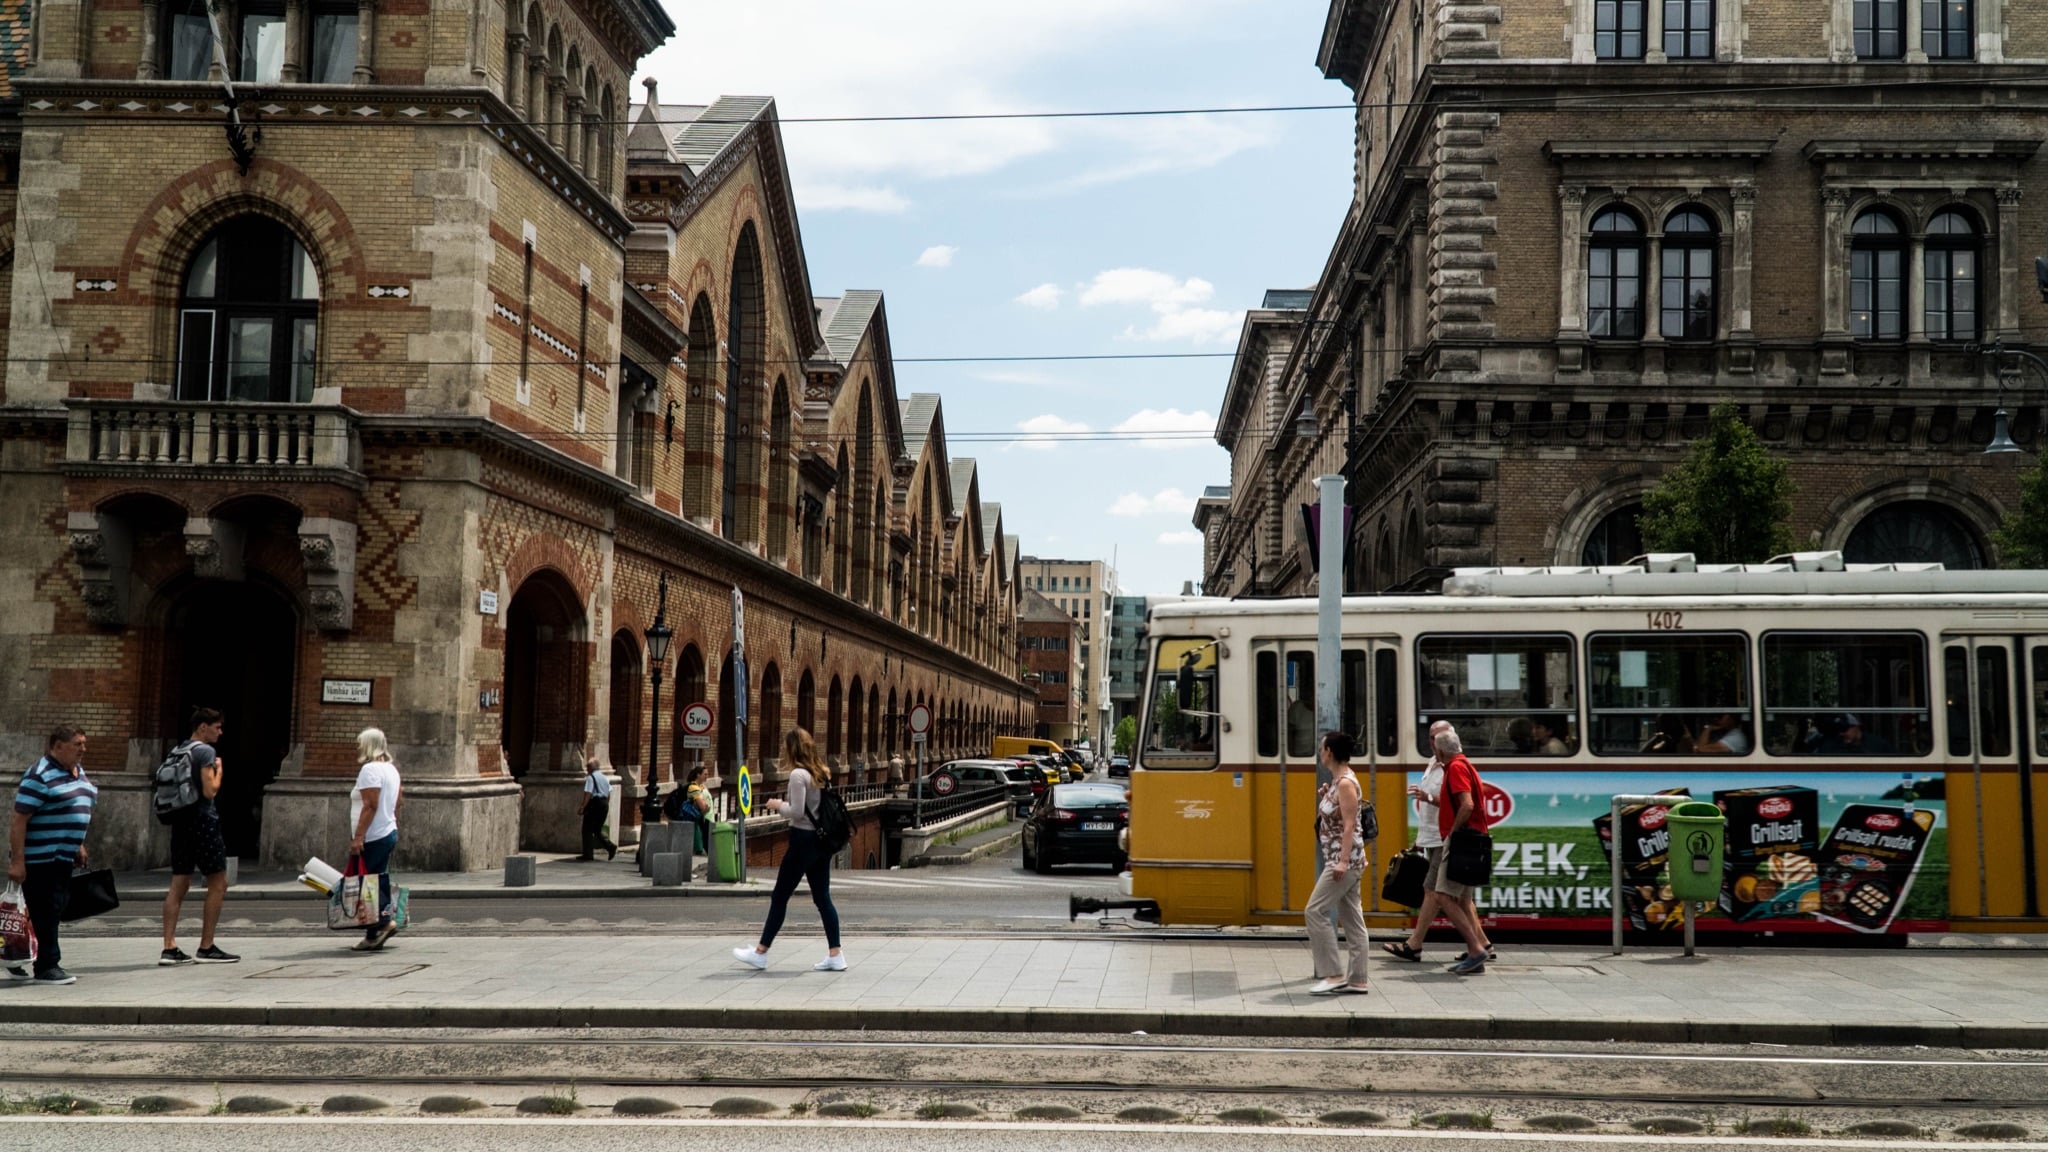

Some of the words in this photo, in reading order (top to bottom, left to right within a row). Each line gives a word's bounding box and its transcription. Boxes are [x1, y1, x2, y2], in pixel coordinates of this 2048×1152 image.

[1647, 611, 1683, 629] 1402
[1638, 829, 1670, 858] Grills
[1751, 819, 1803, 844] Grillsajt
[1834, 827, 1881, 847] Grillsajt
[1878, 833, 1917, 851] rudak
[1492, 842, 1589, 881] ZEK,
[1474, 882, 1614, 909] LMÉNYEK
